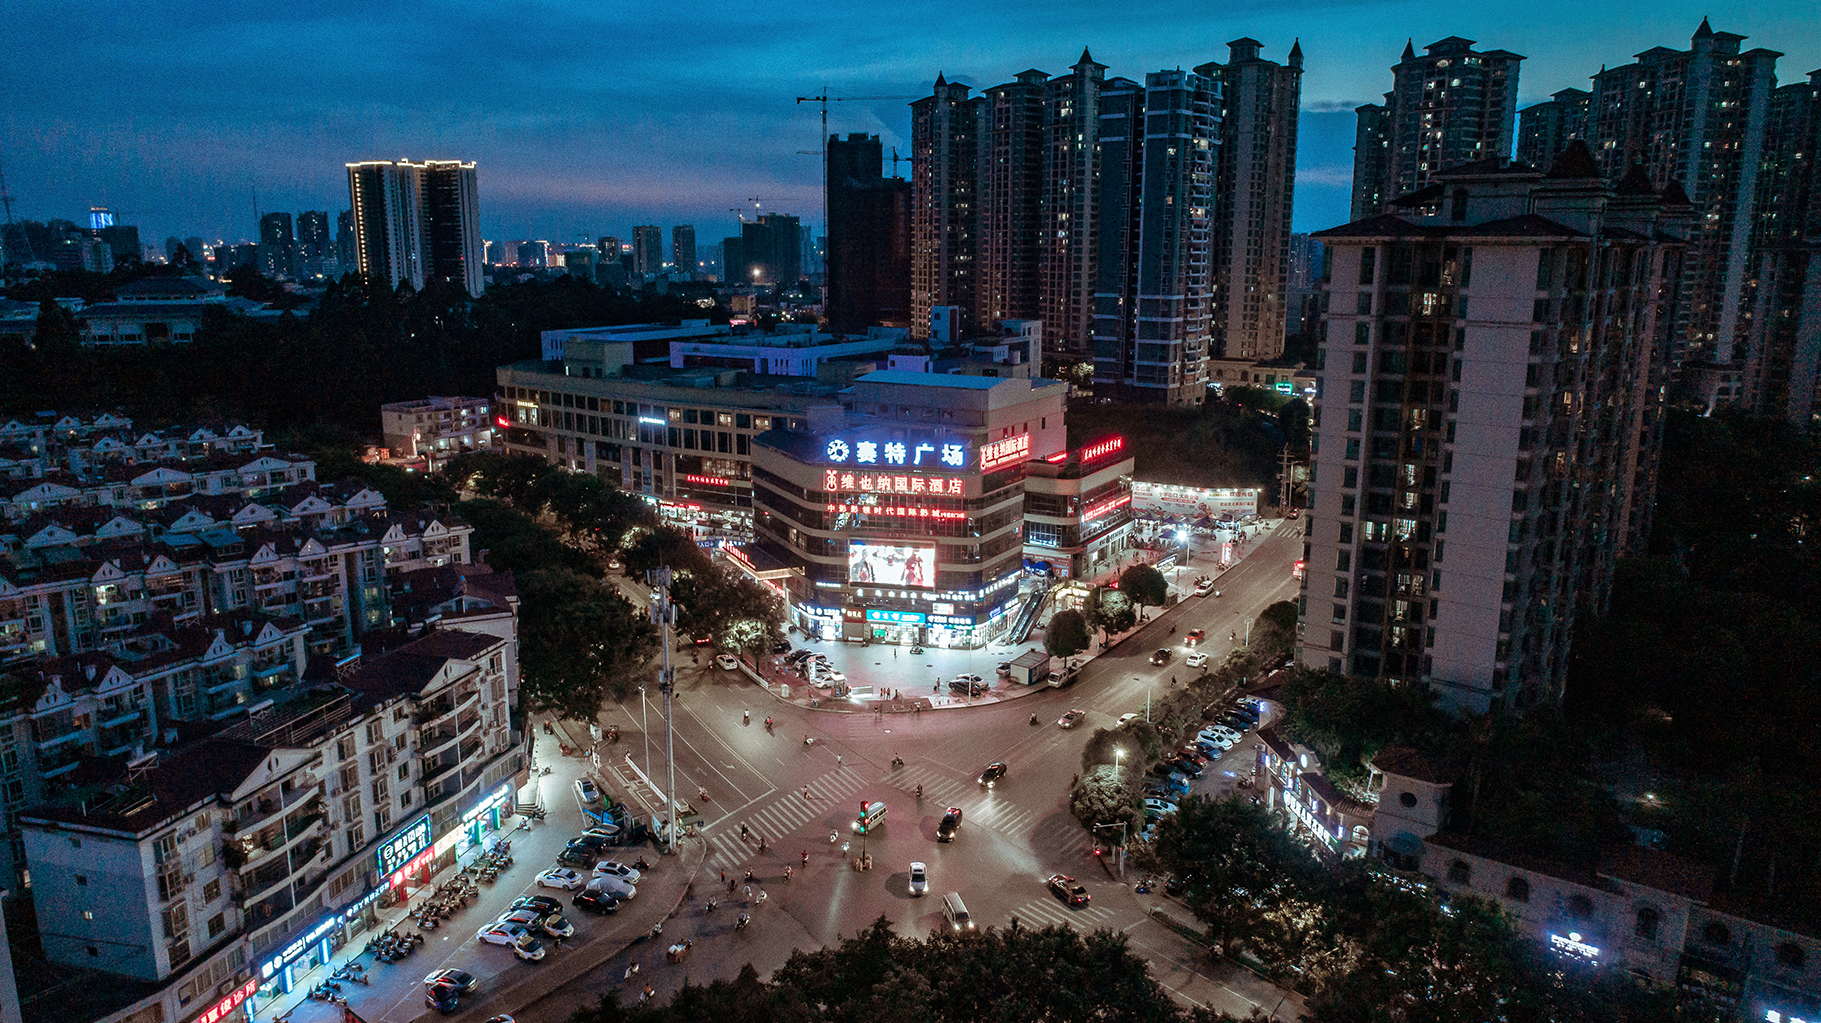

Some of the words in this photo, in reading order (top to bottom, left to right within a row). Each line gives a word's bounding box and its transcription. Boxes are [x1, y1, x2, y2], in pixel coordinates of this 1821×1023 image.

[856, 441, 964, 466] 赛特广场
[987, 434, 1029, 461] 维也纳国际酒店
[840, 474, 963, 495] 维也纳国际酒店
